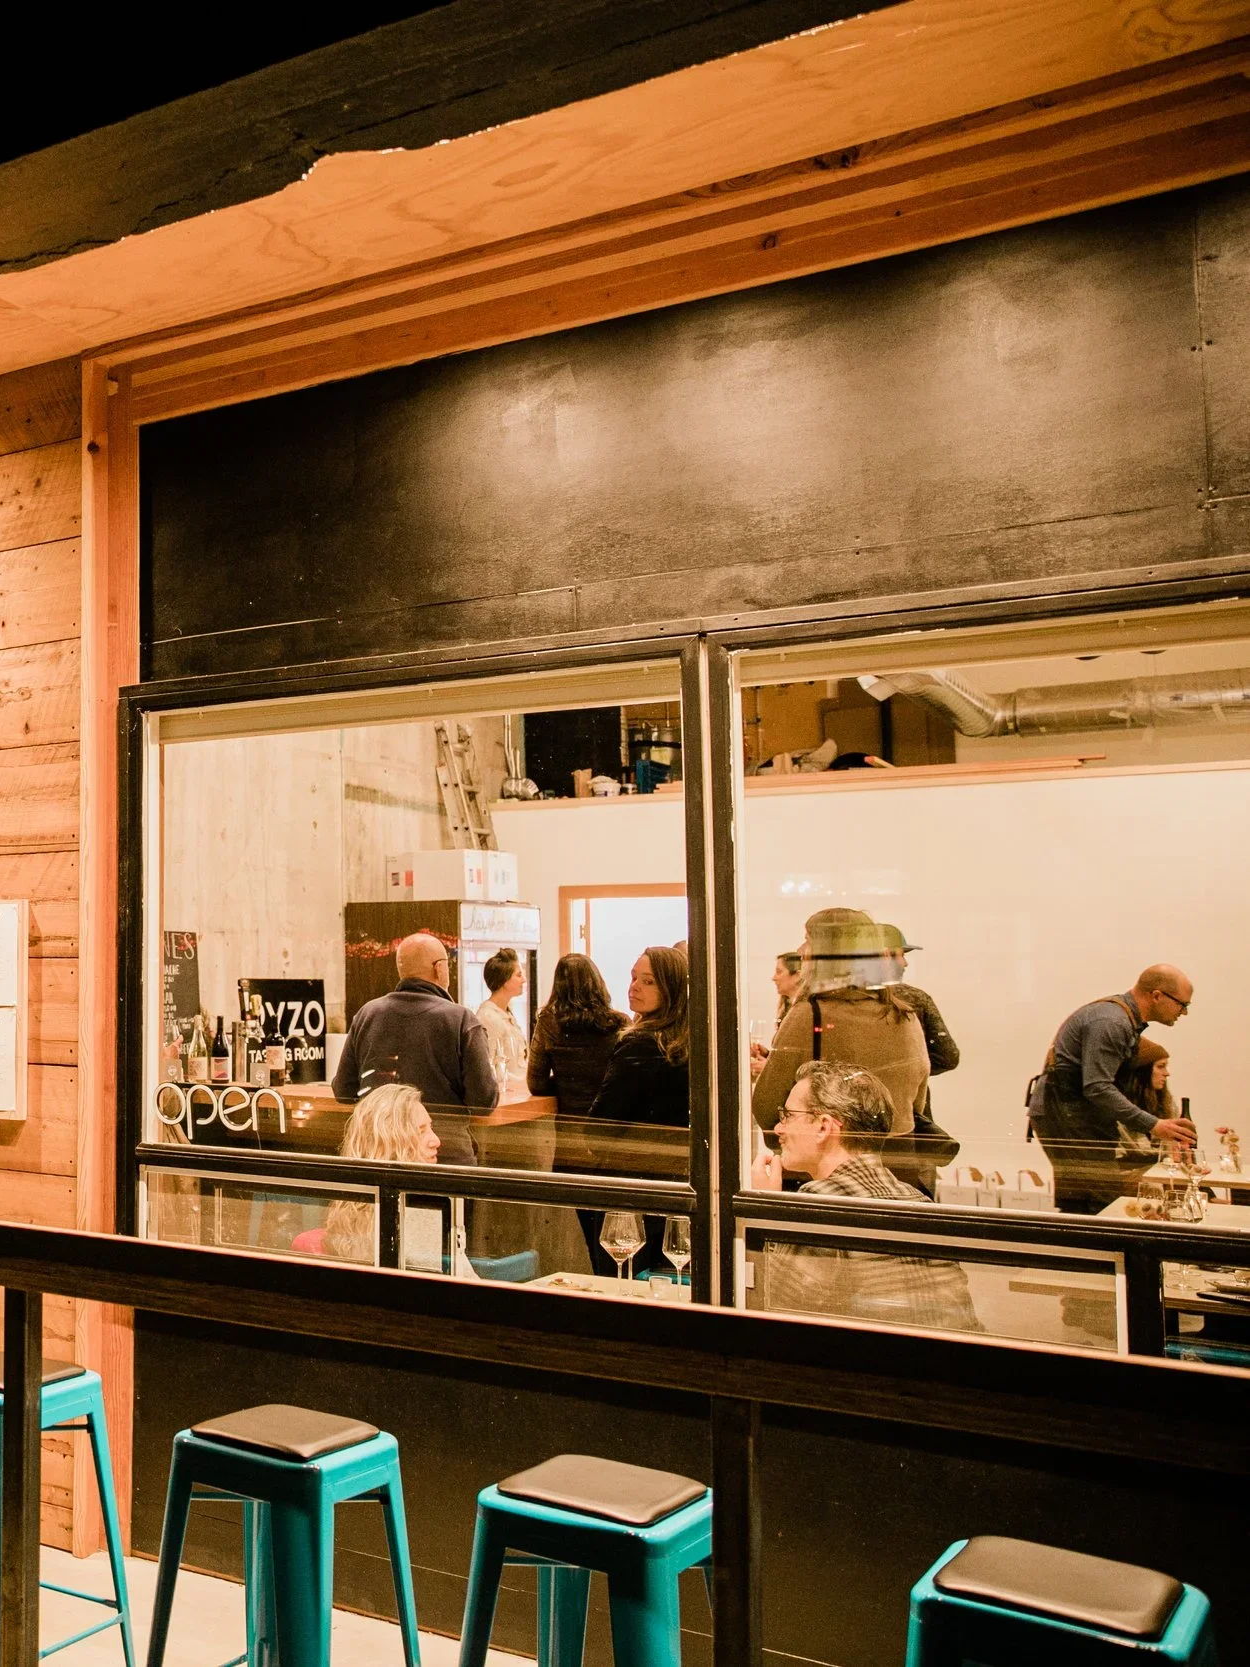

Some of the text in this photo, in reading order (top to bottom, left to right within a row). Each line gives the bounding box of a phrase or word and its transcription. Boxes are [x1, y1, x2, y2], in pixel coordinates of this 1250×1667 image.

[249, 1046, 325, 1063] TASG ROOM
[154, 1082, 287, 1140] open
